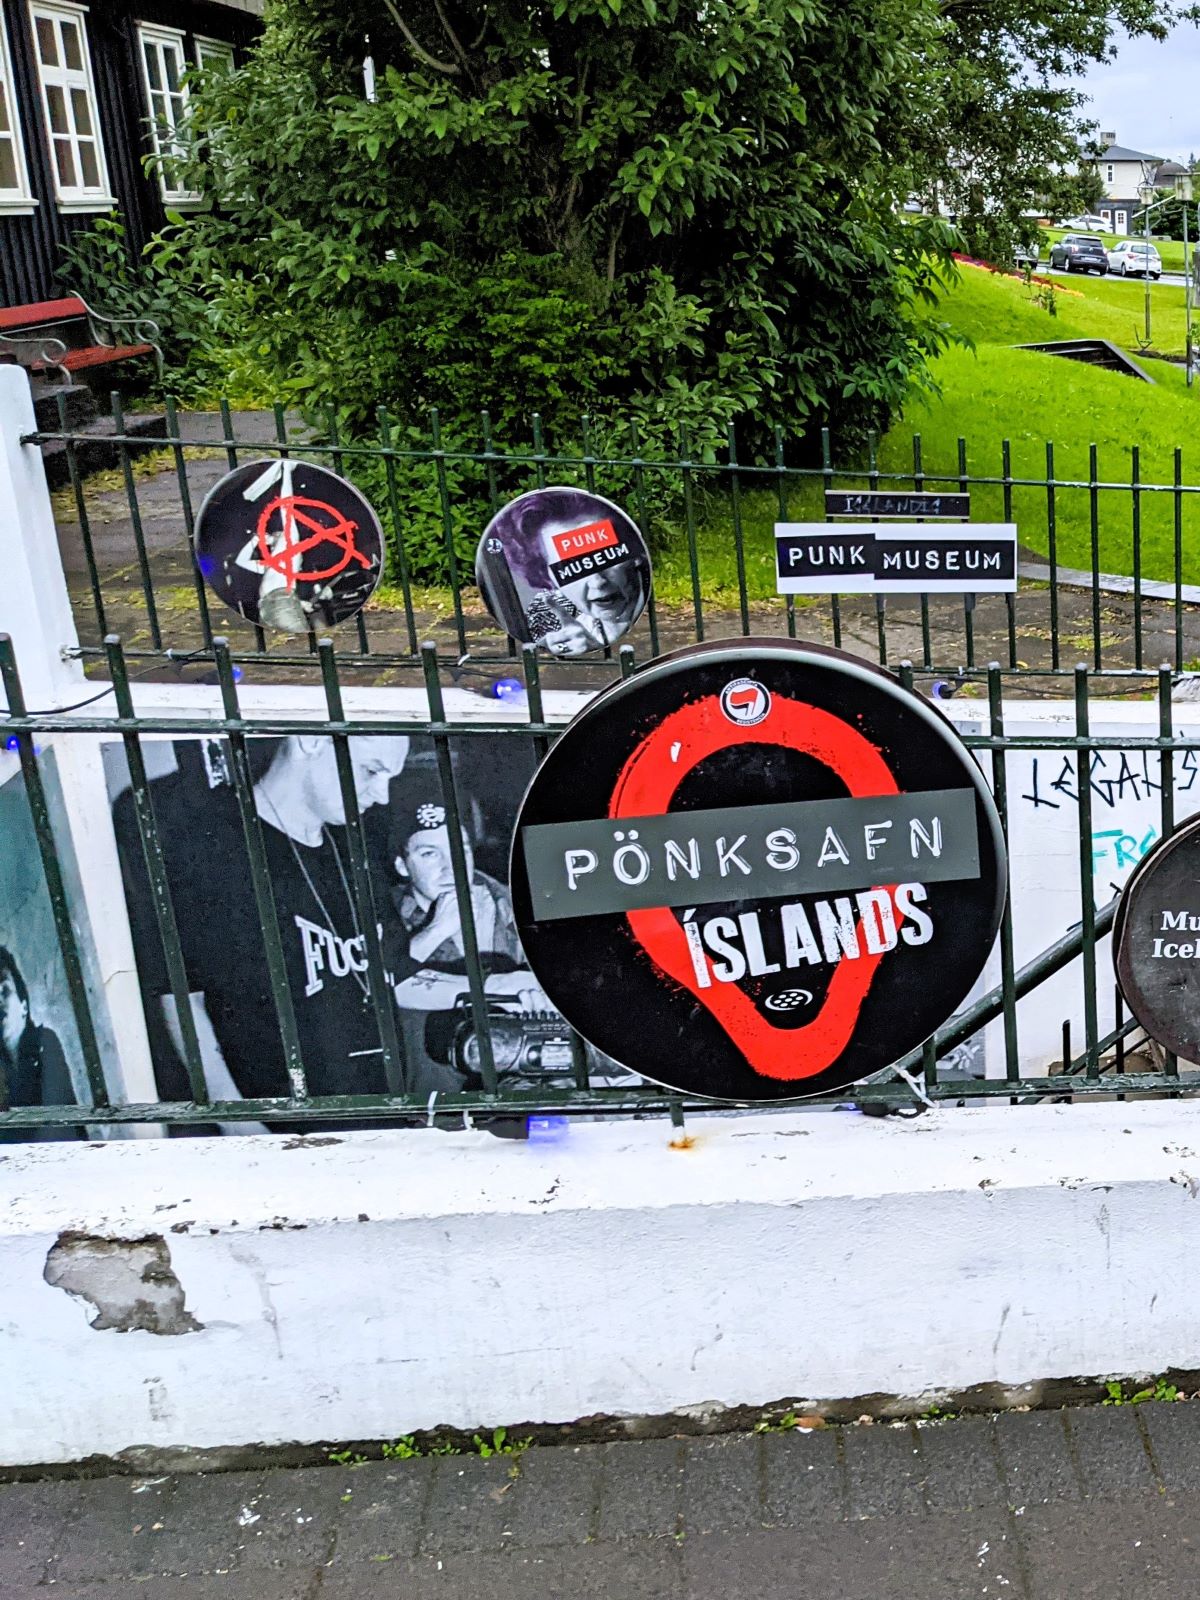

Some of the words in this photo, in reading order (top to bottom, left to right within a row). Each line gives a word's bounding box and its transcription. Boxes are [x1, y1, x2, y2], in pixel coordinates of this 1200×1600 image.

[561, 528, 609, 552] PUNK
[789, 545, 866, 567] PUNK
[883, 550, 1001, 571] MUSEUM
[558, 543, 629, 580] MUSEUM
[564, 816, 944, 891] PÖNKSAFN
[682, 882, 935, 988] ÍSLANDS
